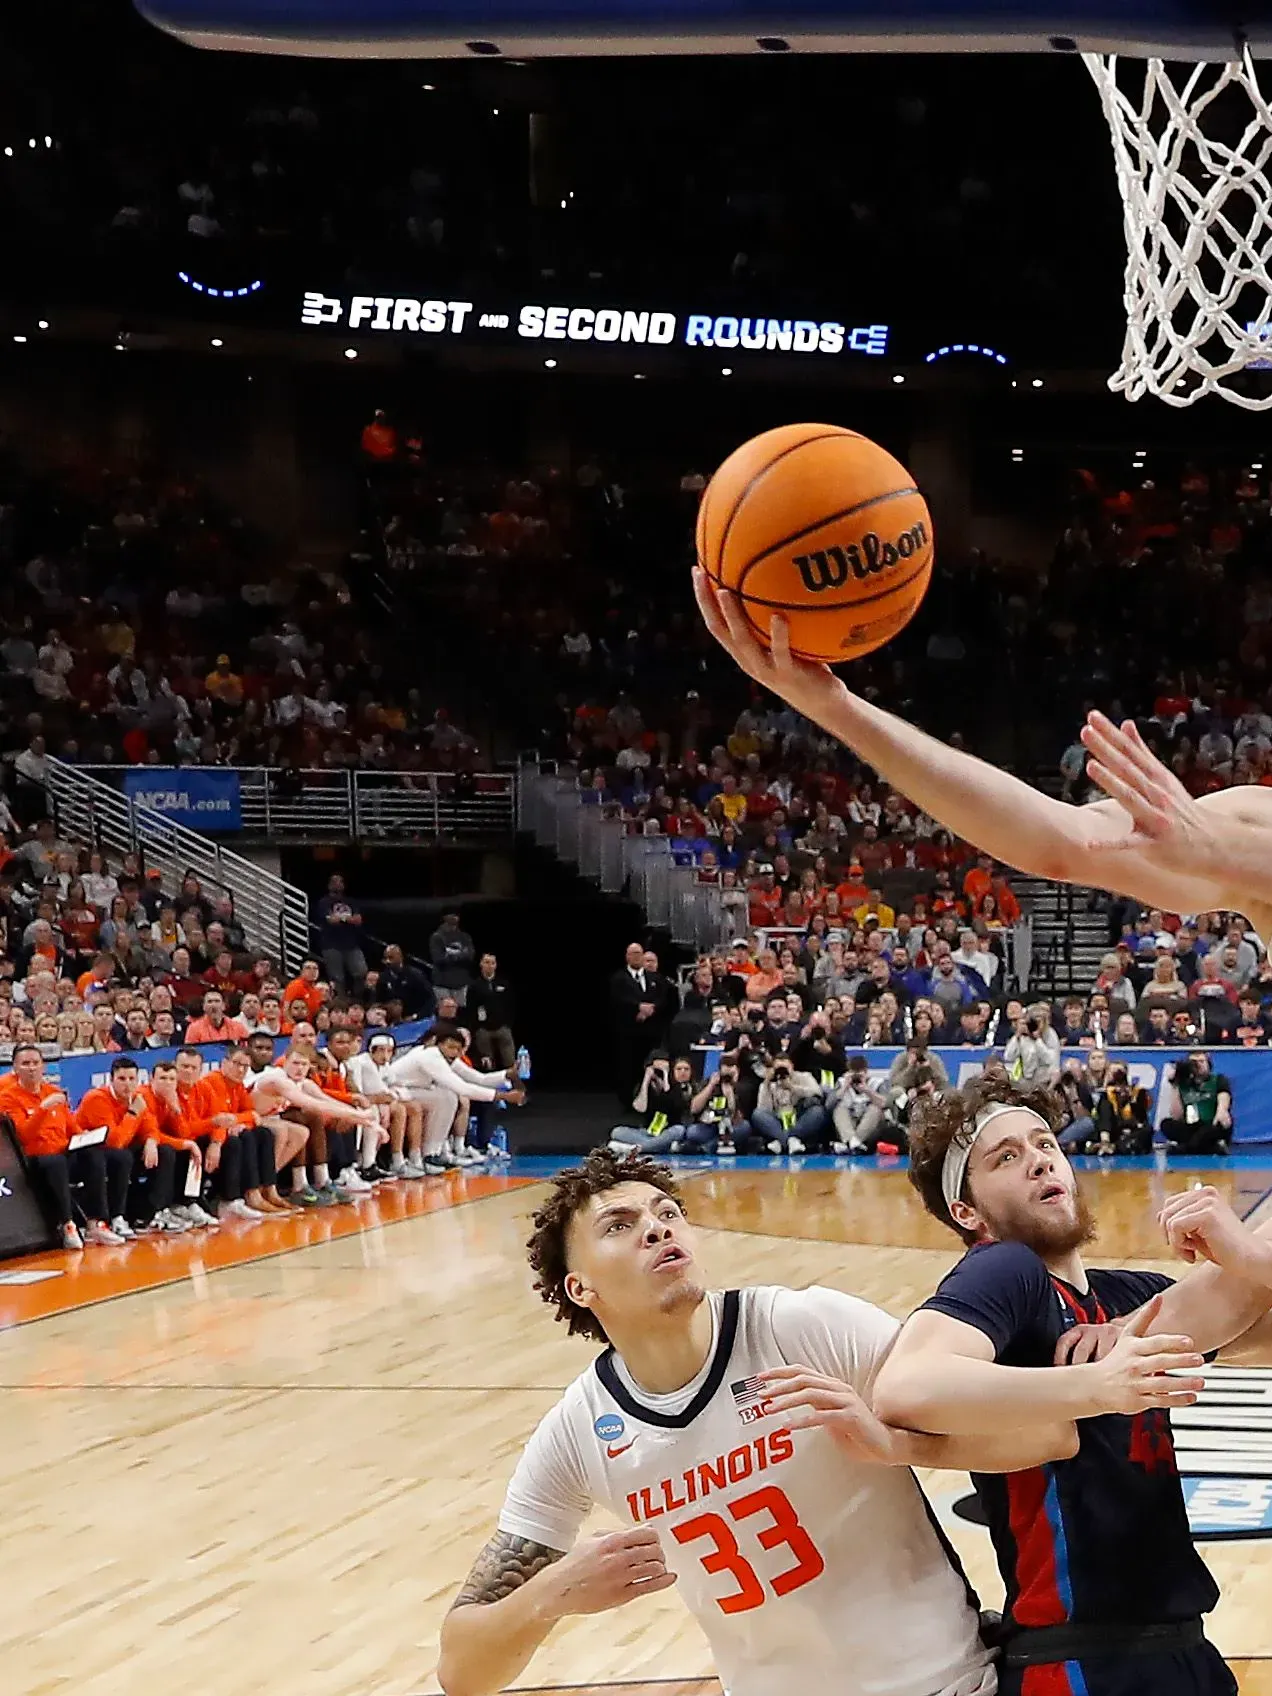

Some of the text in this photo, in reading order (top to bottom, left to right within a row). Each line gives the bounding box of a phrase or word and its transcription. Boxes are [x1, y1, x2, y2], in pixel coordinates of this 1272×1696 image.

[349, 296, 845, 353] FIRST AND SECOND ROUNDS
[792, 520, 928, 593] Wilson
[134, 791, 231, 812] NCAA.com
[626, 1427, 795, 1522] ILLINOIS
[670, 1484, 825, 1615] 33
